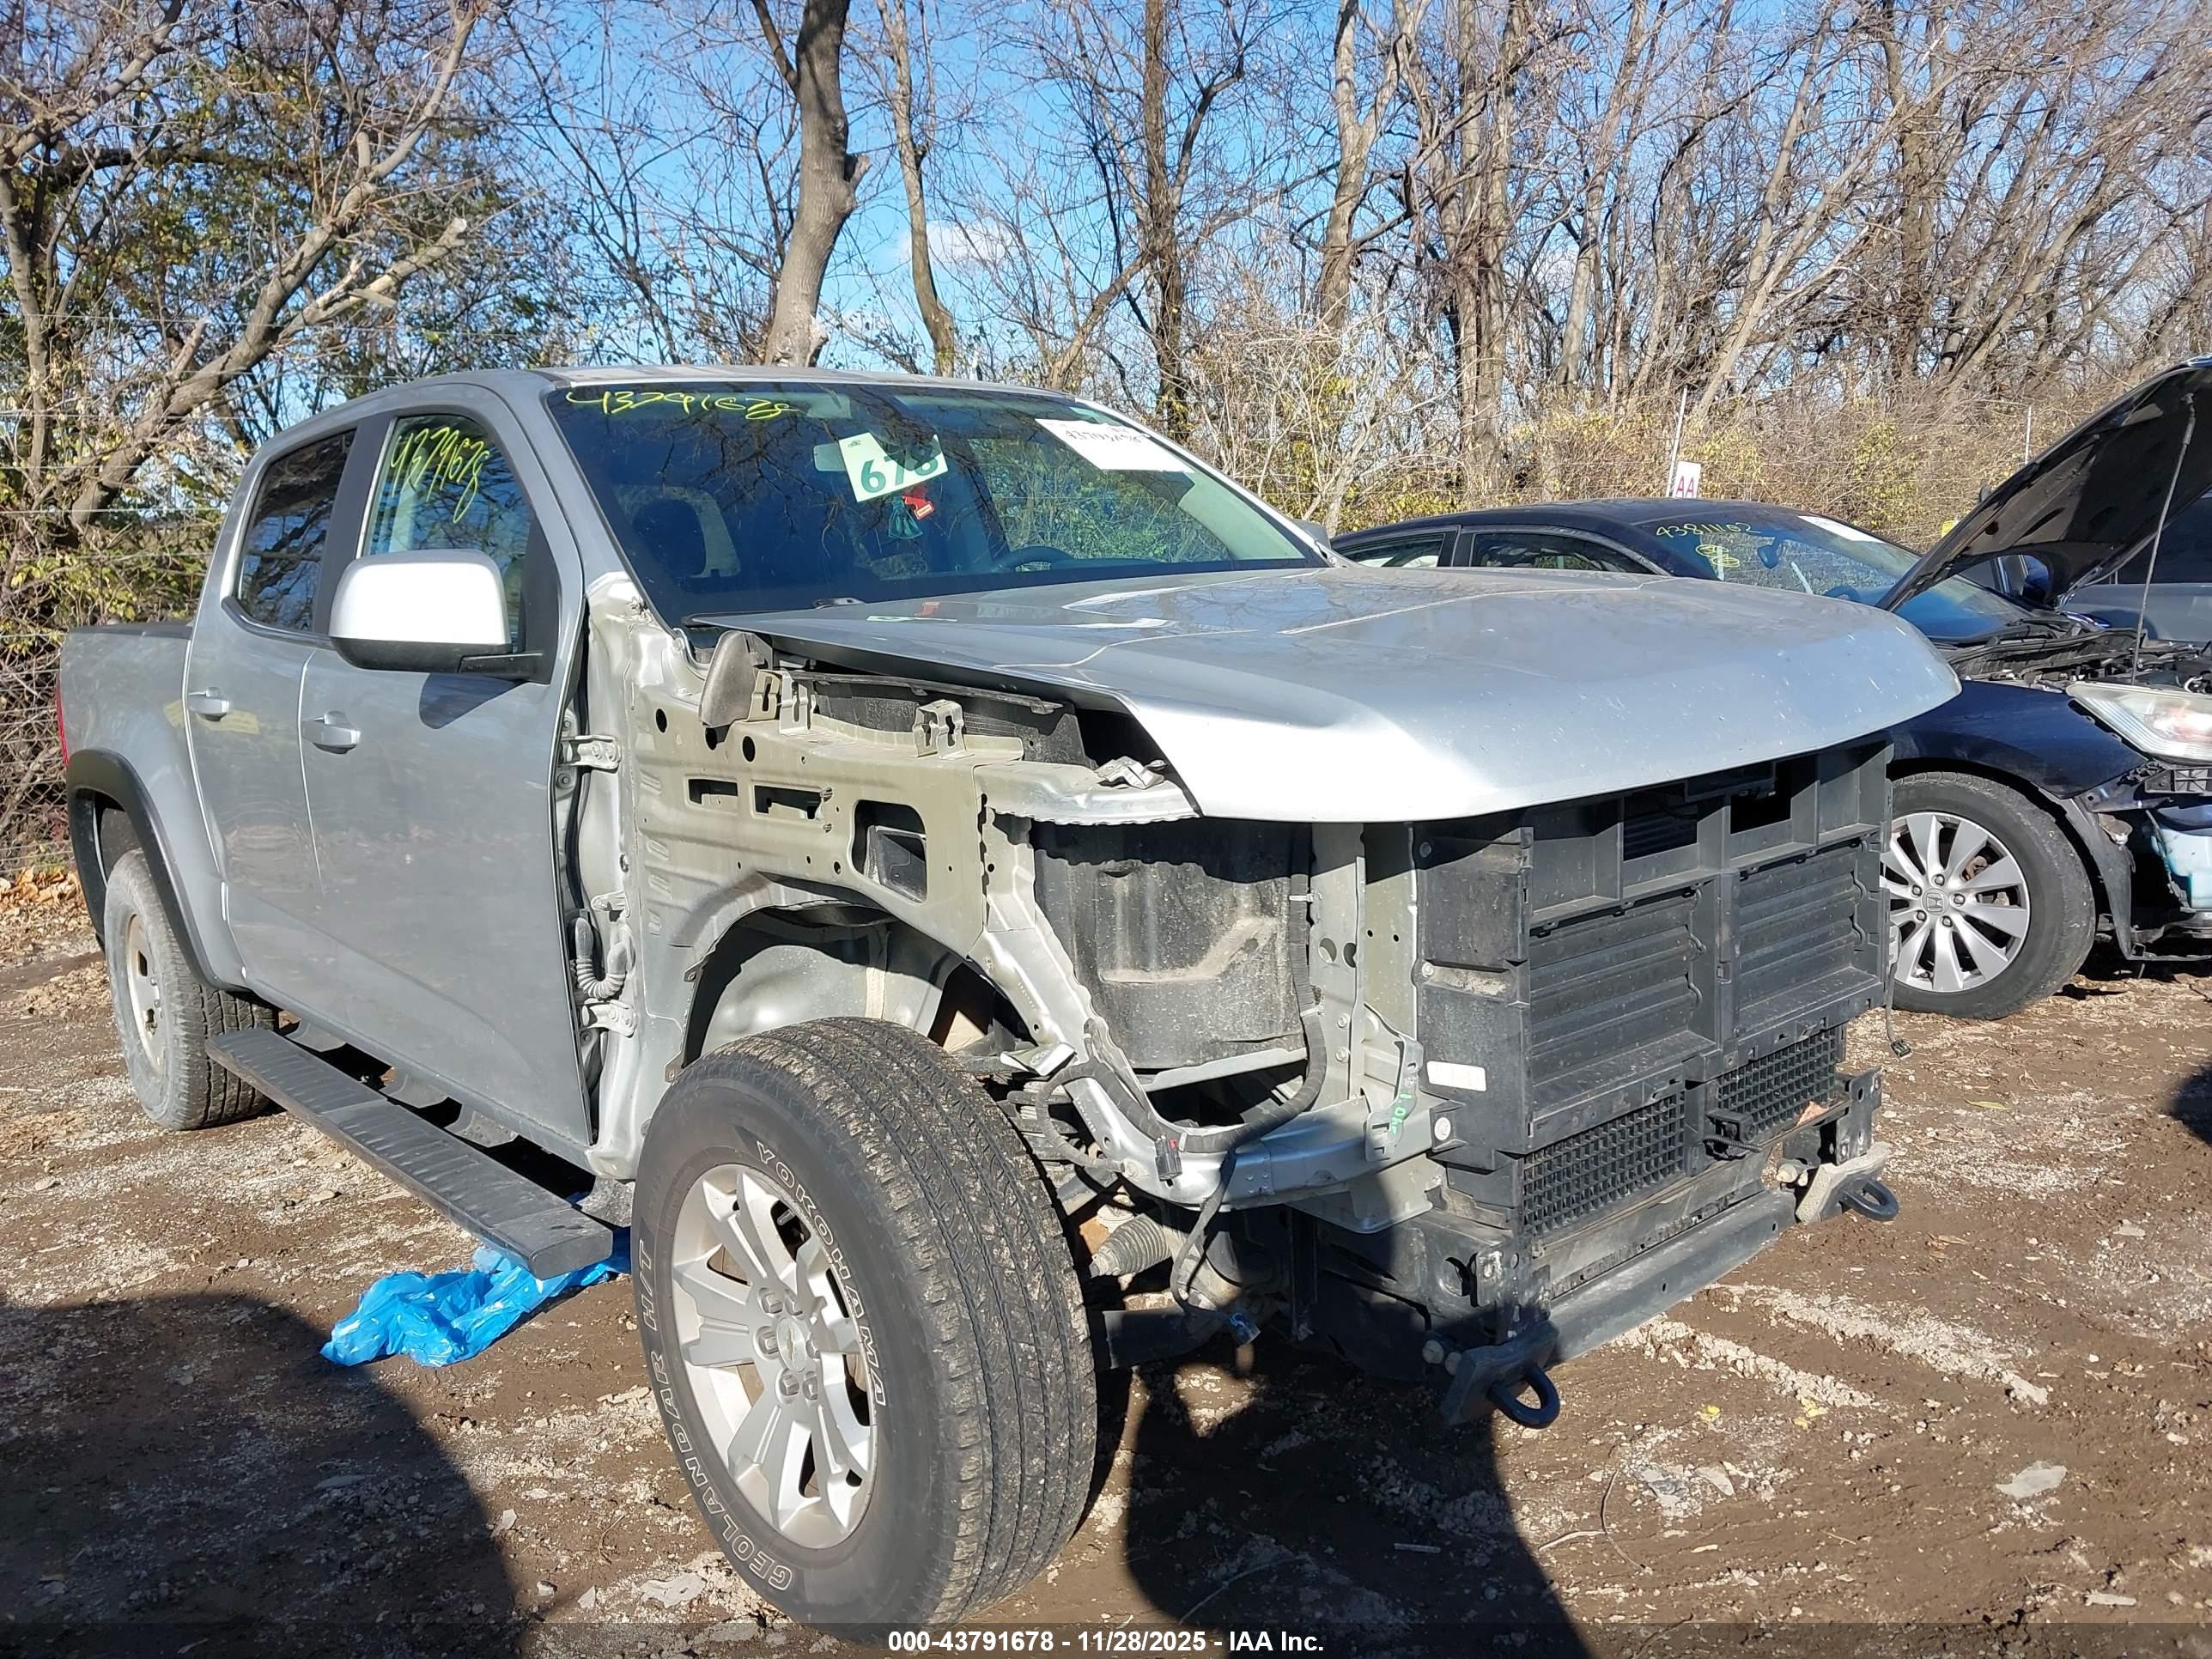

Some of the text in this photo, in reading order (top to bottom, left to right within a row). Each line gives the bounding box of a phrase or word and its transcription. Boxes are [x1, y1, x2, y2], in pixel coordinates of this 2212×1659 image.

[1675, 476, 1695, 498] AA
[756, 1140, 887, 1407] YOKOHAMA
[639, 1239, 793, 1591] GEOLANDAR H/T
